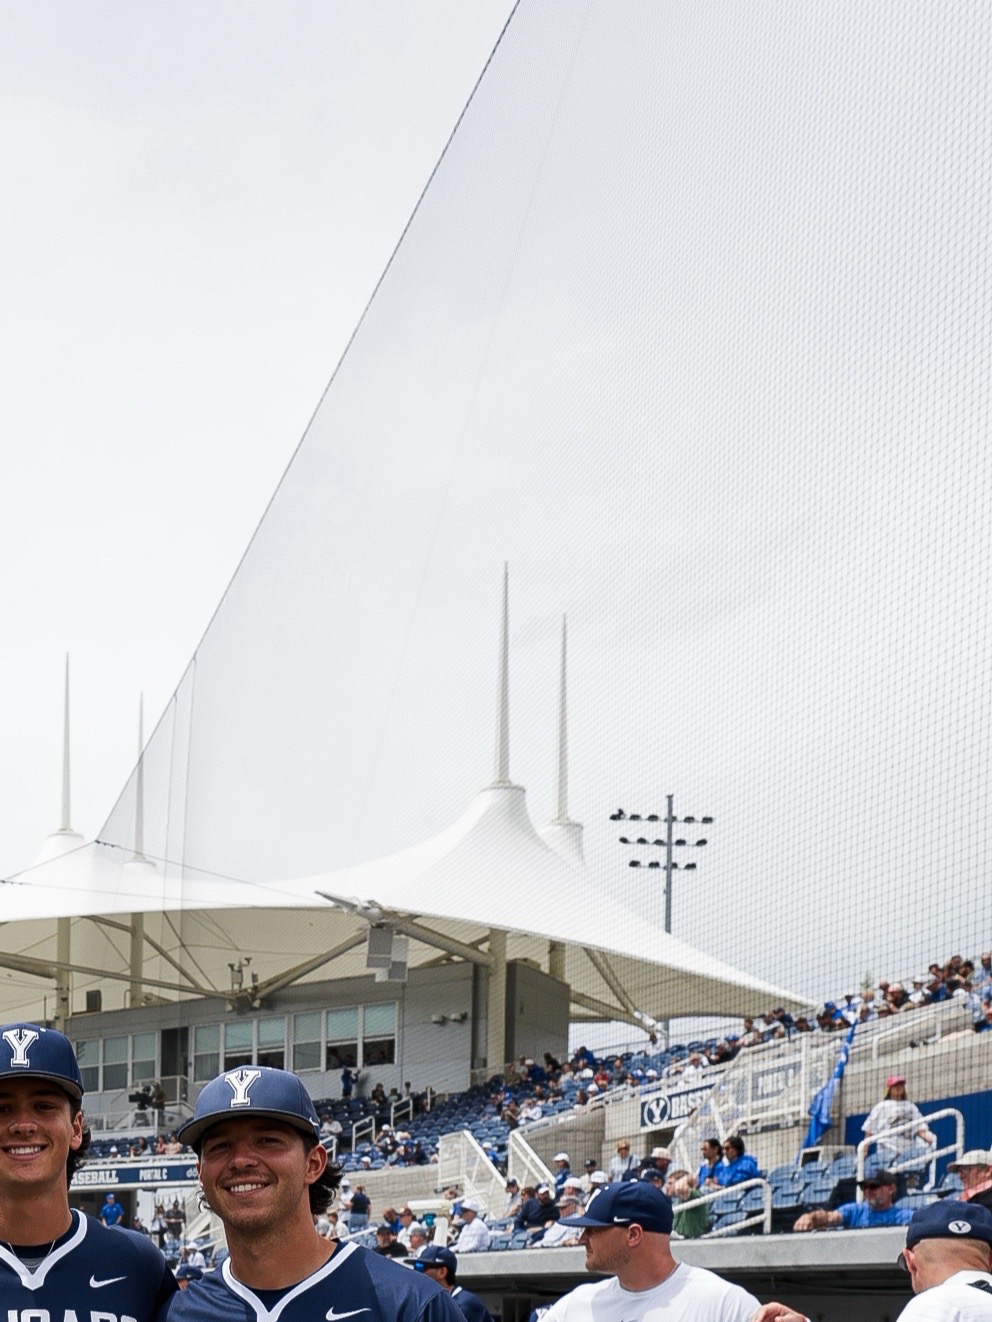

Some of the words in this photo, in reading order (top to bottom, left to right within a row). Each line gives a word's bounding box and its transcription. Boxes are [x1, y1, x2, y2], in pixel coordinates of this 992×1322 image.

[2, 1028, 39, 1068] Y
[224, 1069, 262, 1108] Y
[71, 1170, 119, 1185] ASEBALL
